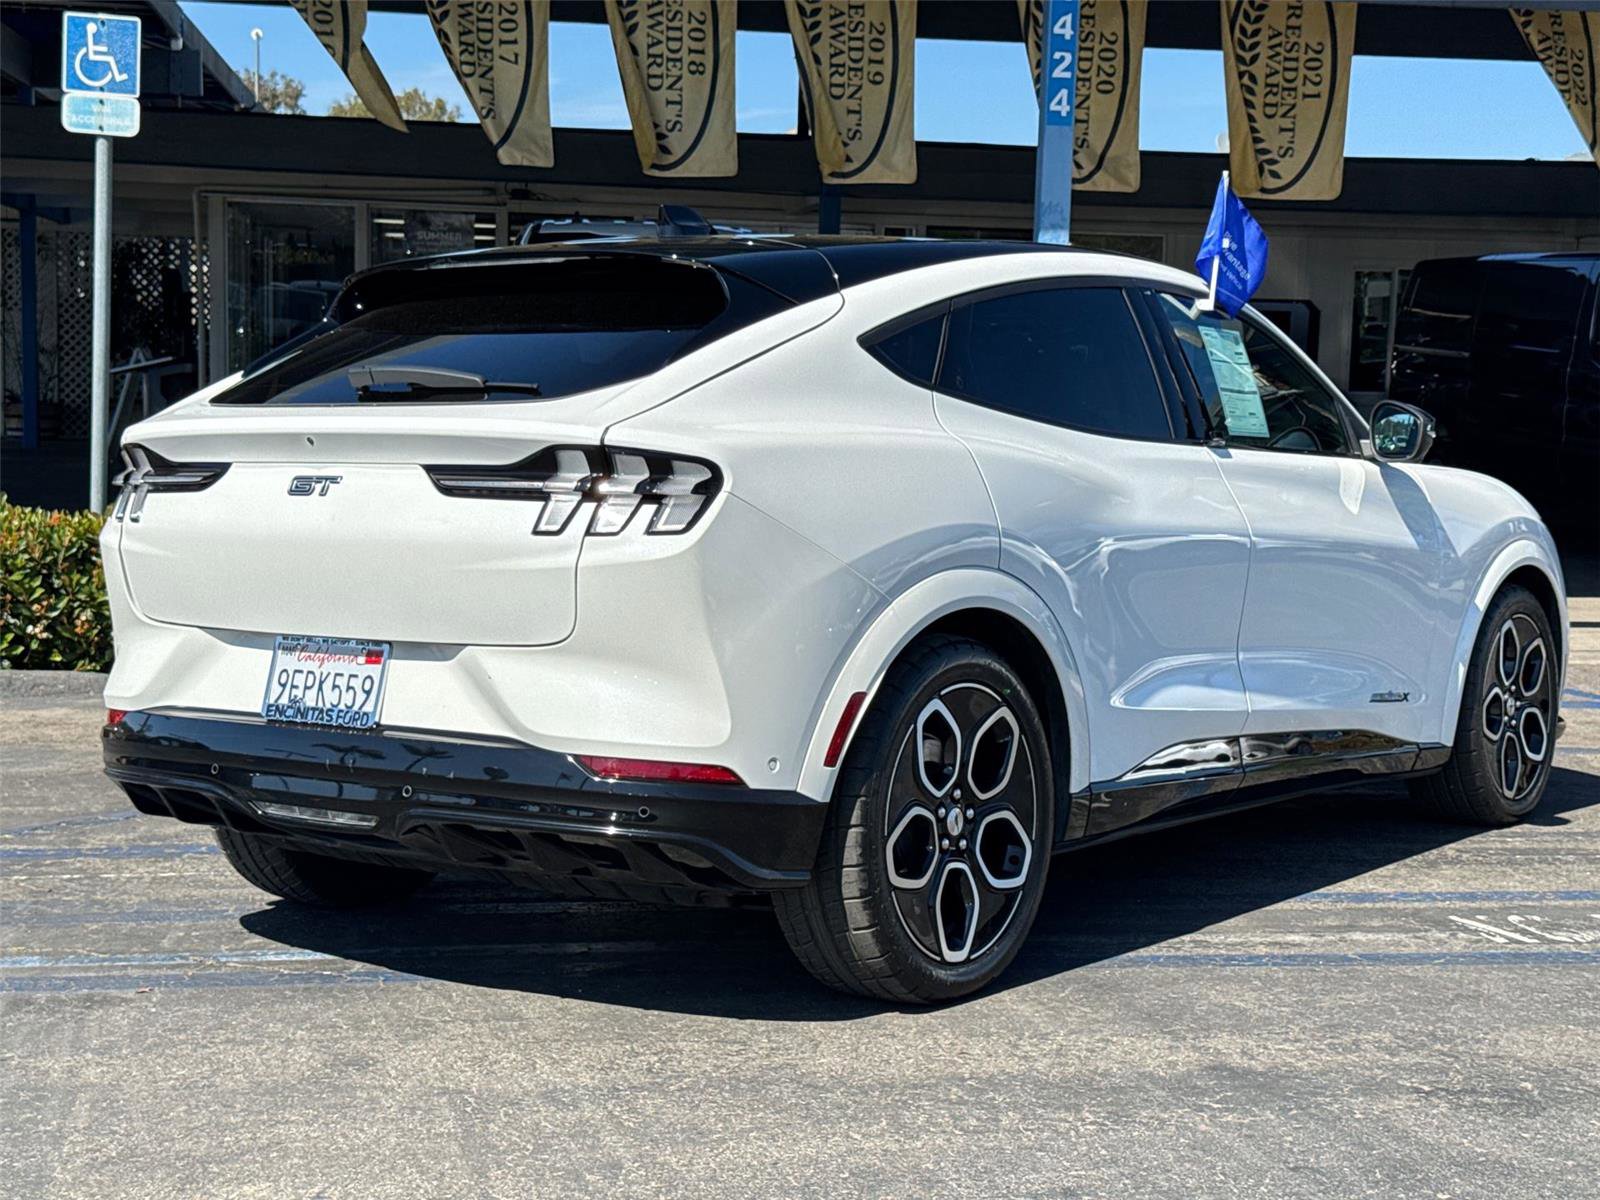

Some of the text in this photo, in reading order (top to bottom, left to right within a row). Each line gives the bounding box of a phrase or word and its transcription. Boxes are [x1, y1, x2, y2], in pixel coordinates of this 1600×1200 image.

[498, 2, 519, 66] 2017
[687, 11, 707, 76] 2018
[828, 4, 846, 100] AWARD
[867, 21, 886, 86] 2019
[1048, 0, 1074, 117] 424
[1095, 31, 1119, 95] 2020
[1262, 24, 1283, 120] AWARD
[1277, 0, 1303, 159] RESIDENT'S
[1301, 42, 1325, 101] 2021
[1569, 47, 1588, 106] 2022
[287, 475, 343, 496] GT
[265, 703, 370, 727] ENCINITAS FORD
[274, 668, 375, 711] 9EPK559
